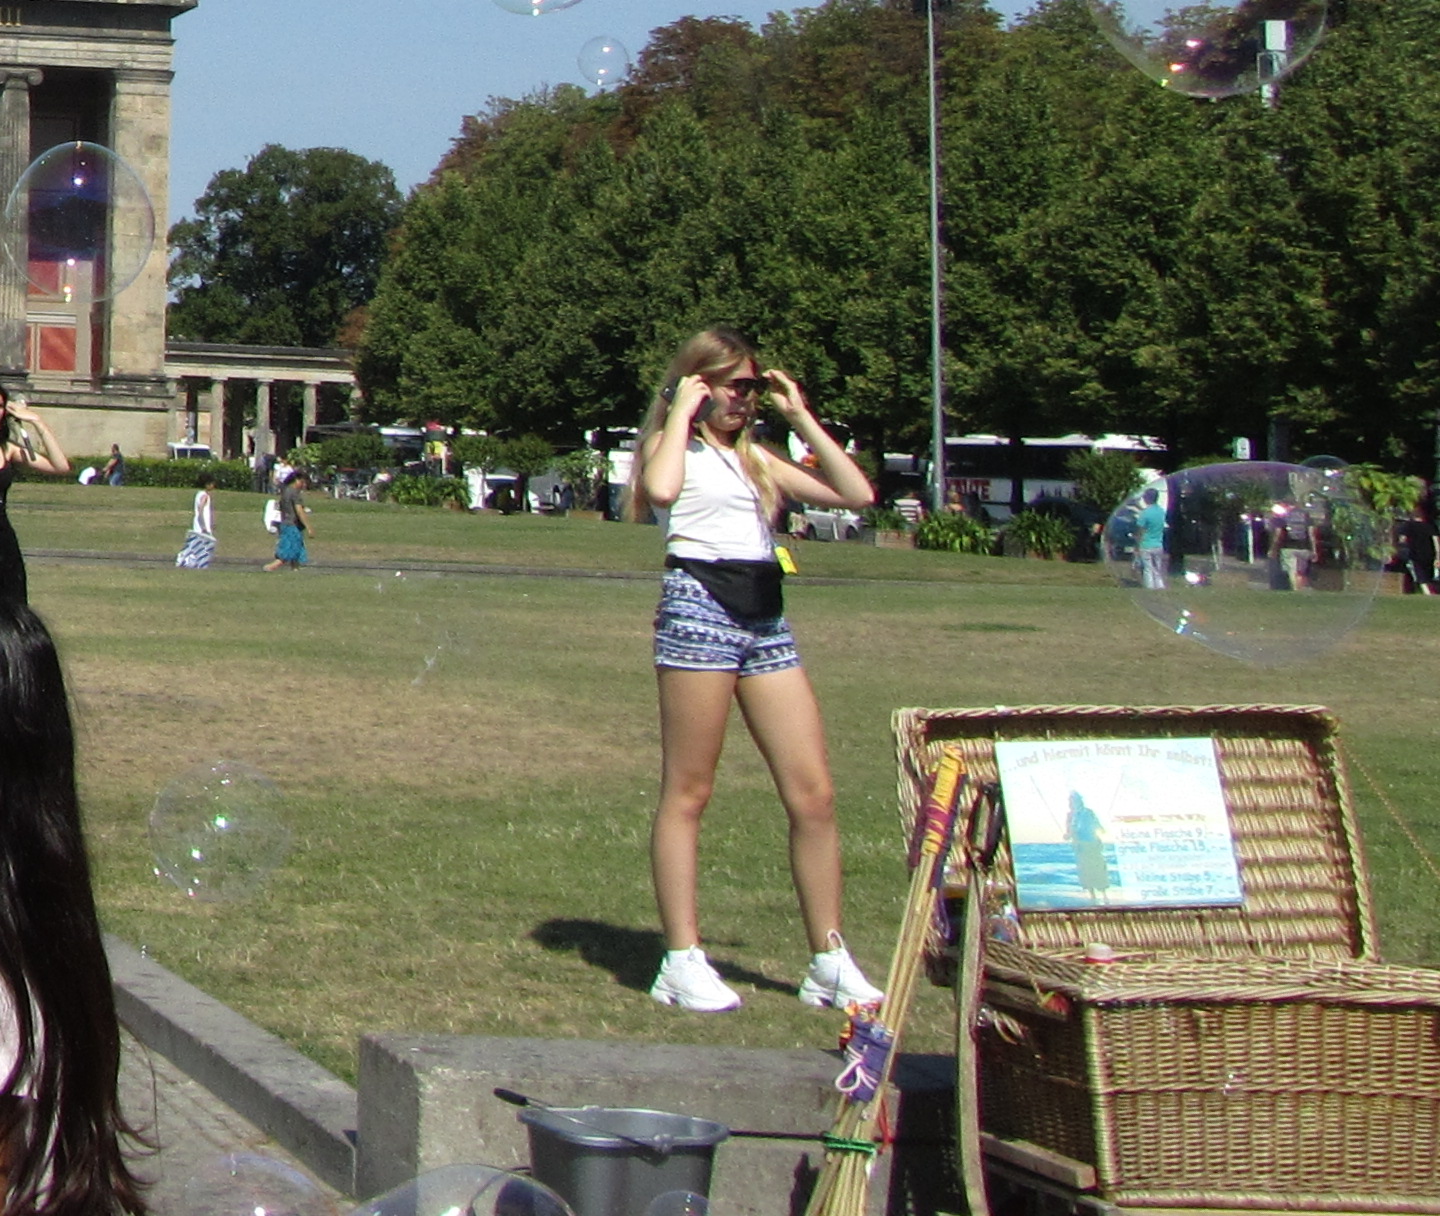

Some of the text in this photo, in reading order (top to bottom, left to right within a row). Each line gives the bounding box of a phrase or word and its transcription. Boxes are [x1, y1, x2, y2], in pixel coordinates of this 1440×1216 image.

[1043, 744, 1091, 761] hiermit
[1095, 742, 1132, 756] könnt
[1137, 743, 1161, 759] Ihr
[1166, 749, 1213, 768] selbst:
[1120, 828, 1151, 839] kleine
[1154, 827, 1193, 839] Flasche
[1150, 840, 1188, 853] Flasche
